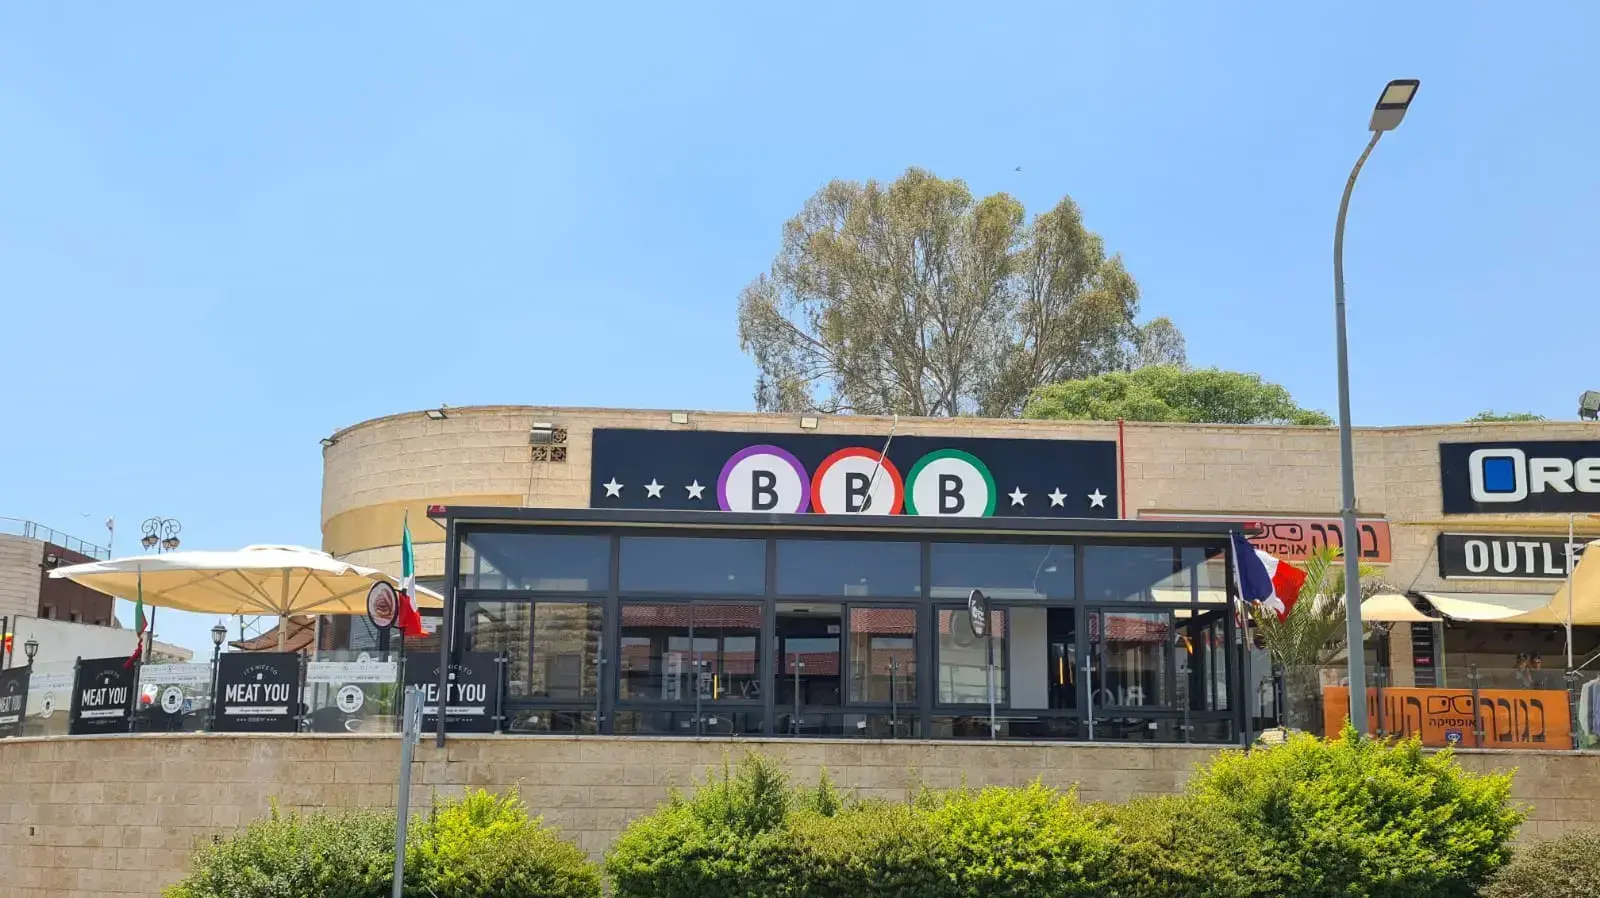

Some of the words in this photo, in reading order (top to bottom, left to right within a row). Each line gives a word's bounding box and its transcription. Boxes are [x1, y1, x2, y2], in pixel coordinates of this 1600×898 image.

[752, 470, 778, 510] B
[845, 472, 872, 513] B
[938, 474, 965, 514] B
[81, 687, 108, 706] MEAT
[108, 686, 128, 705] YOU
[225, 683, 261, 702] MEAT
[263, 683, 290, 702] YOU
[457, 683, 486, 702] YOU
